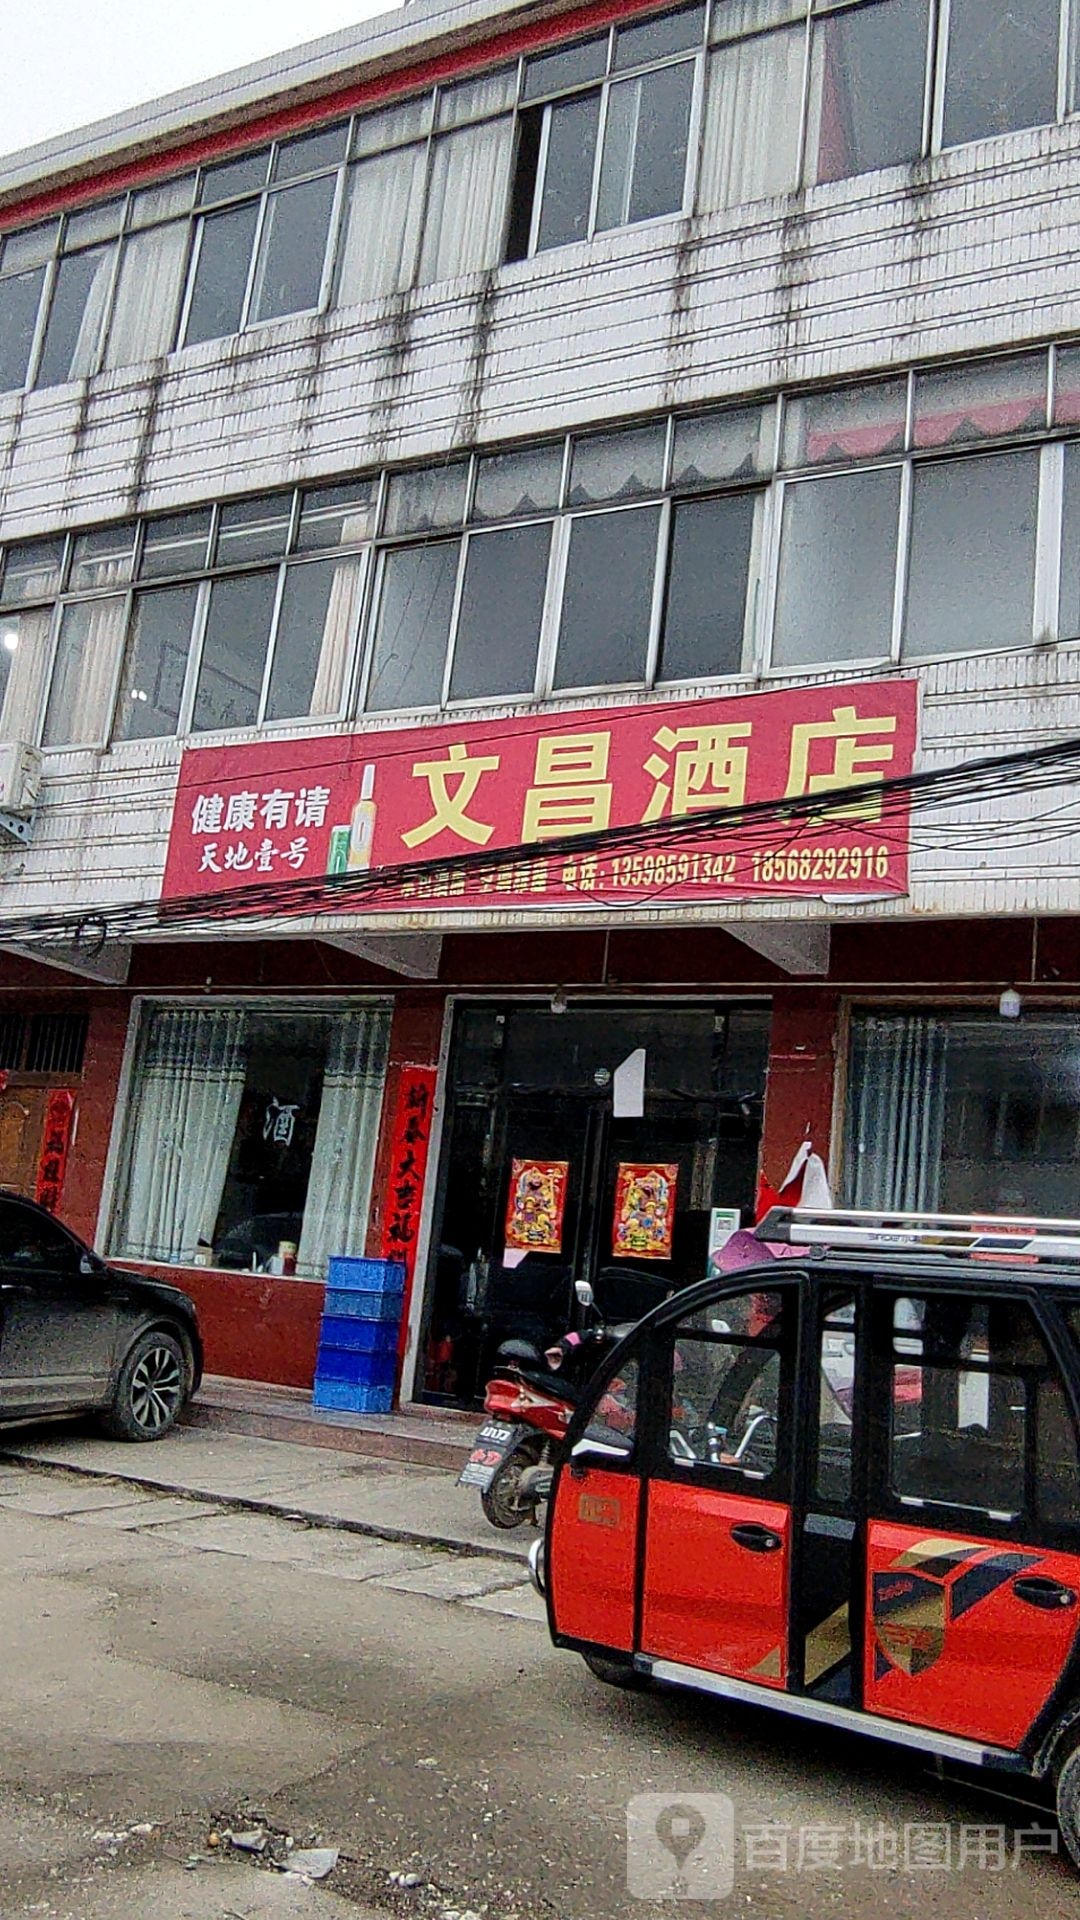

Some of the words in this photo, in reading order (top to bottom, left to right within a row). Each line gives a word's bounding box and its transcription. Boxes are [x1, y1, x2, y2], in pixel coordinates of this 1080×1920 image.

[400, 706, 896, 848] 文昌酒店
[191, 785, 331, 834] 健康有请
[197, 837, 309, 873] 天地壹号
[751, 846, 889, 882] 18568292916
[262, 1096, 300, 1147] 酒
